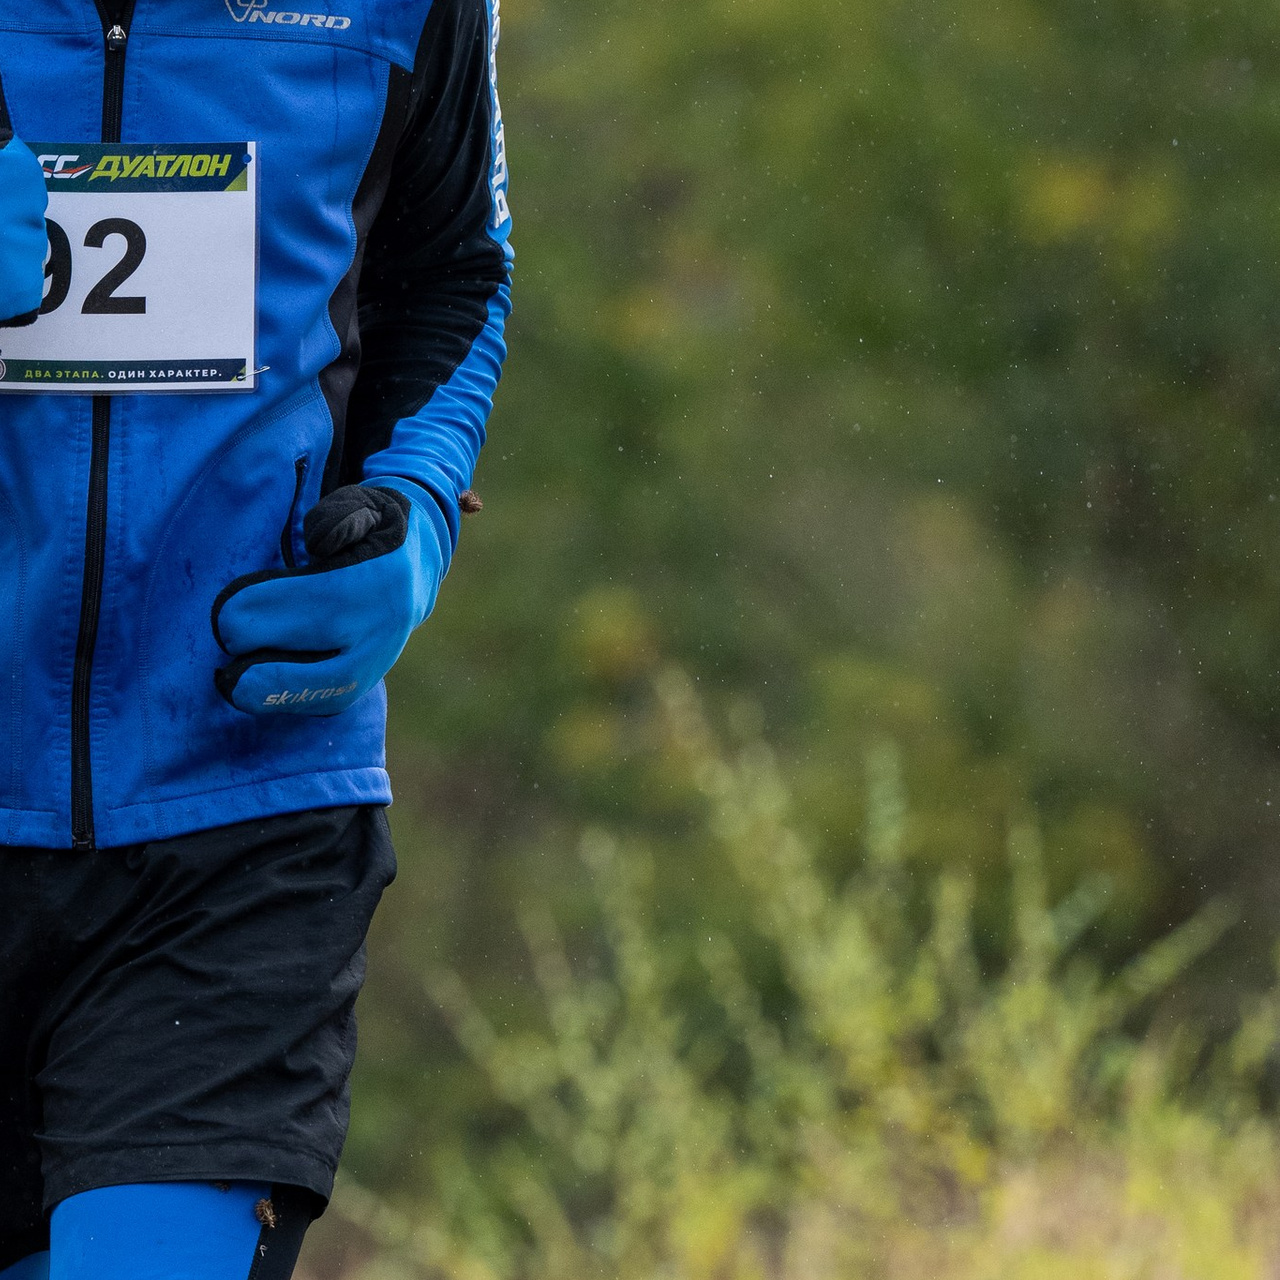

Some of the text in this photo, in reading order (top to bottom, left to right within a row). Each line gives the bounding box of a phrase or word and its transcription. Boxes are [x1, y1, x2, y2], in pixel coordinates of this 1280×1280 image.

[248, 10, 352, 30] NORD
[87, 154, 232, 182] ДУАТЛОН
[39, 216, 147, 316] 92
[24, 368, 223, 380] ДВА ЭТАПА. ОДИН ХАРАКТЕР.
